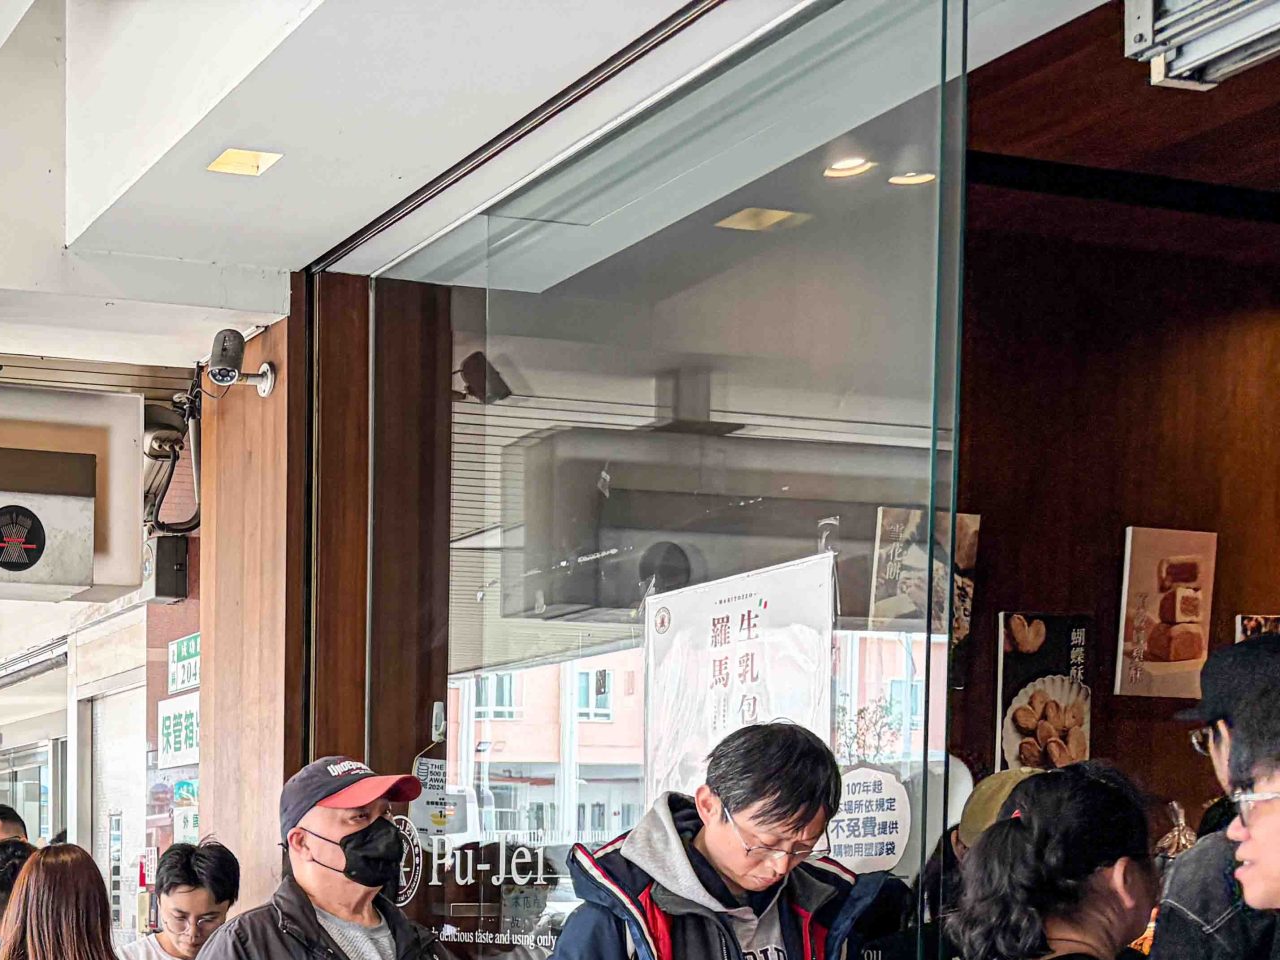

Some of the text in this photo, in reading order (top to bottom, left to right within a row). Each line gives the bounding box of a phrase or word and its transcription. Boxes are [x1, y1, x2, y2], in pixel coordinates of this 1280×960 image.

[710, 614, 731, 690] 羅馬
[846, 780, 883, 795] 107年起
[830, 816, 899, 839] 不免費提供
[428, 832, 548, 886] Pu-Jei
[833, 841, 896, 857] 購物用塑膠袋
[495, 930, 510, 944] and
[512, 930, 535, 949] using
[536, 929, 557, 950] only
